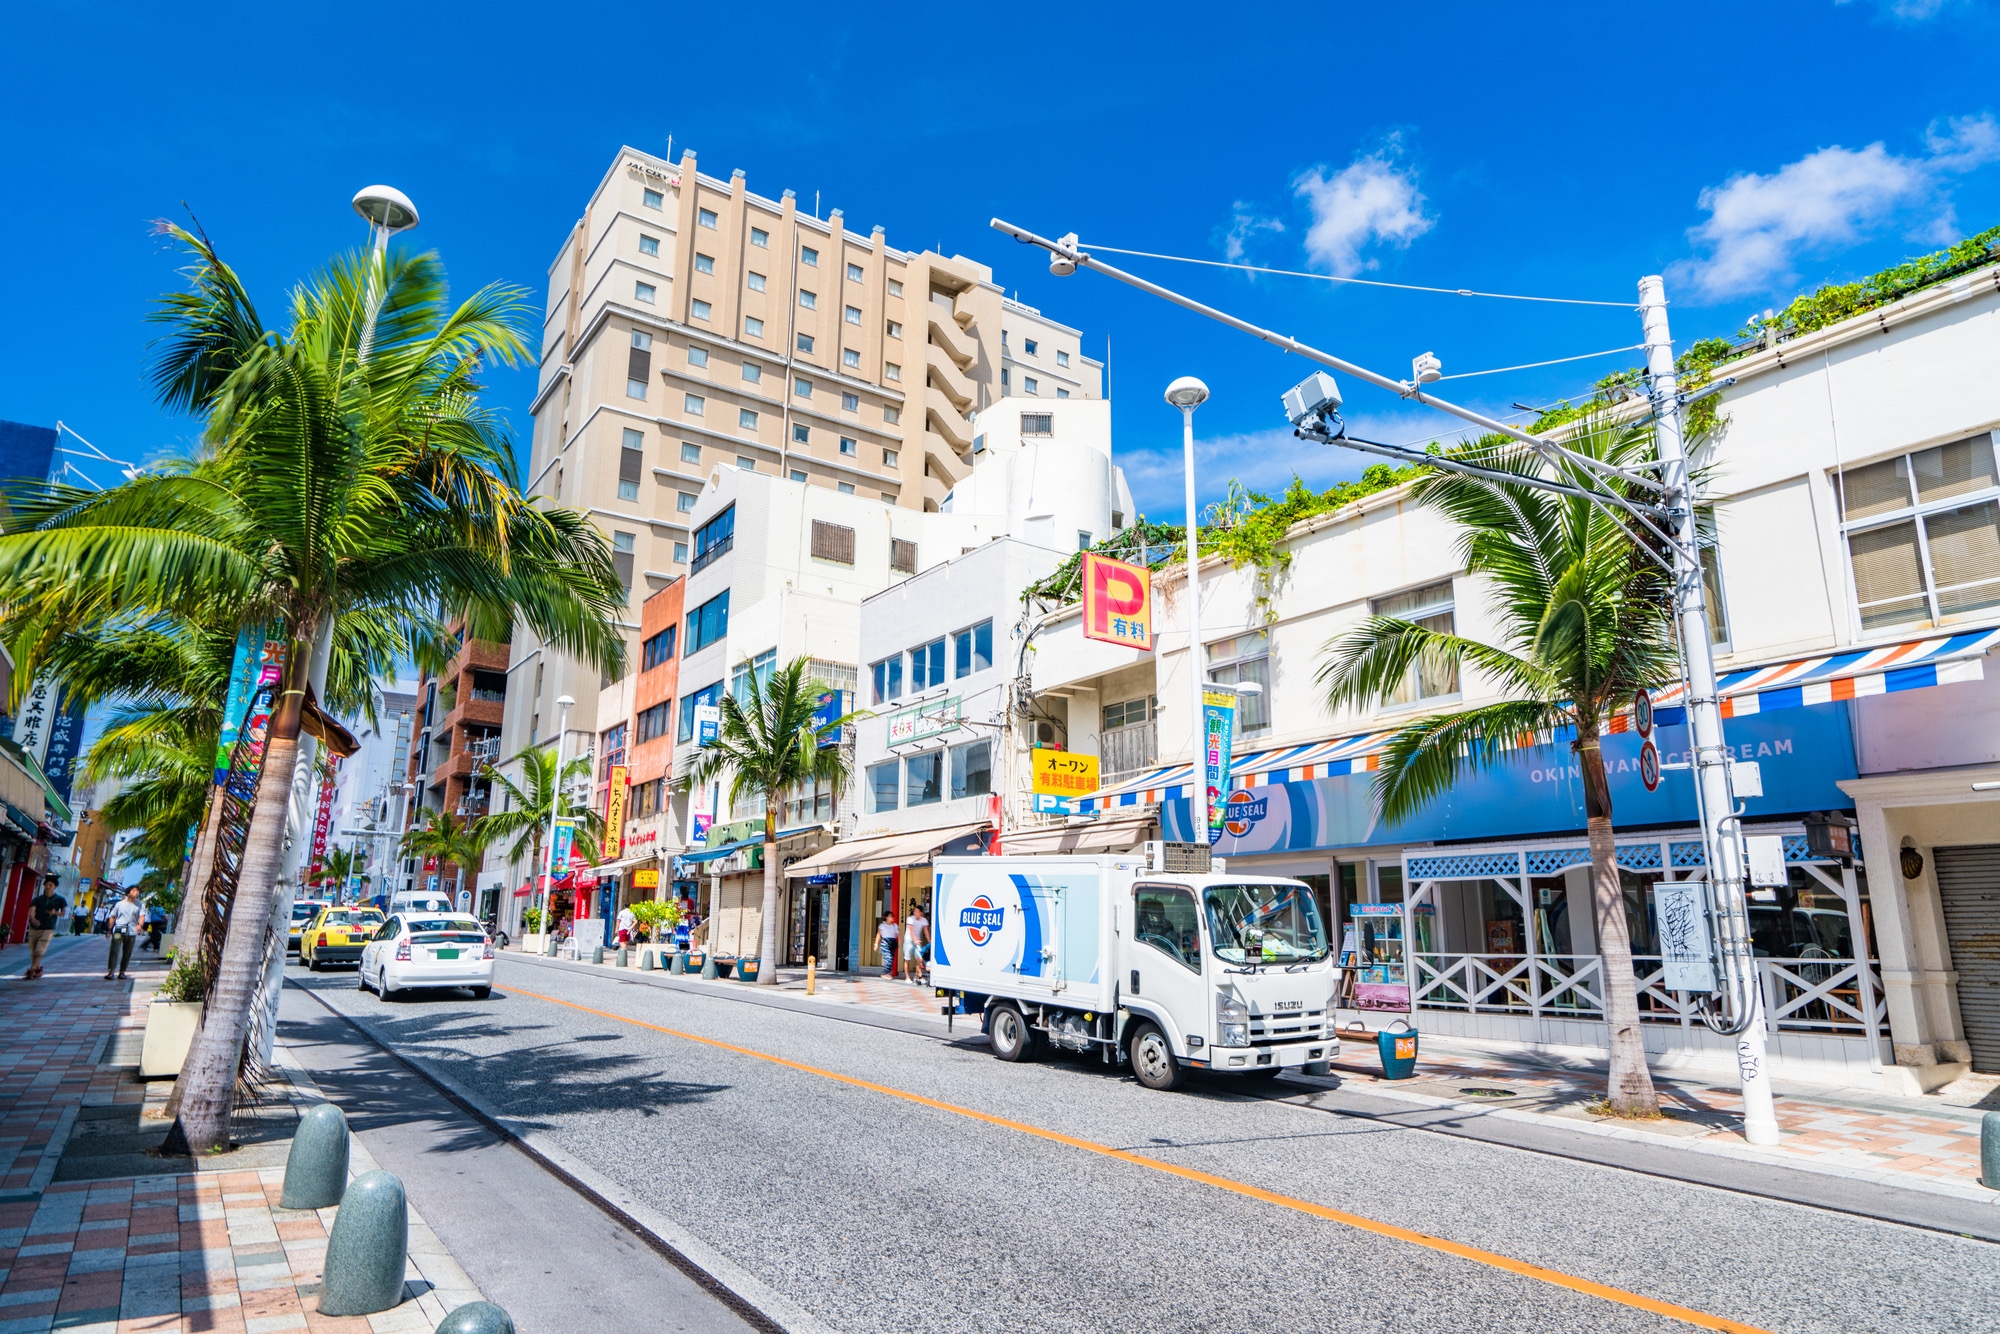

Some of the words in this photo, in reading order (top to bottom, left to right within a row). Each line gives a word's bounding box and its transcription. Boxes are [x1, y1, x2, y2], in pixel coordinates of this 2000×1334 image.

[627, 162, 644, 171] JAL
[645, 168, 669, 180] CITY
[1094, 561, 1145, 634] P
[1113, 617, 1145, 641] 有料
[1638, 701, 1649, 725] 30
[1048, 758, 1089, 773] オーワン
[1531, 757, 1642, 783] OKINWAN
[1725, 739, 1793, 761] REAM
[1040, 772, 1097, 792] 有料駐車場
[1039, 794, 1057, 811] P
[1226, 807, 1240, 819] UE
[1242, 804, 1265, 817] SEAL
[962, 911, 981, 924] BLUE
[982, 912, 1002, 926] SEAL
[1274, 1001, 1303, 1010] ISUZU
